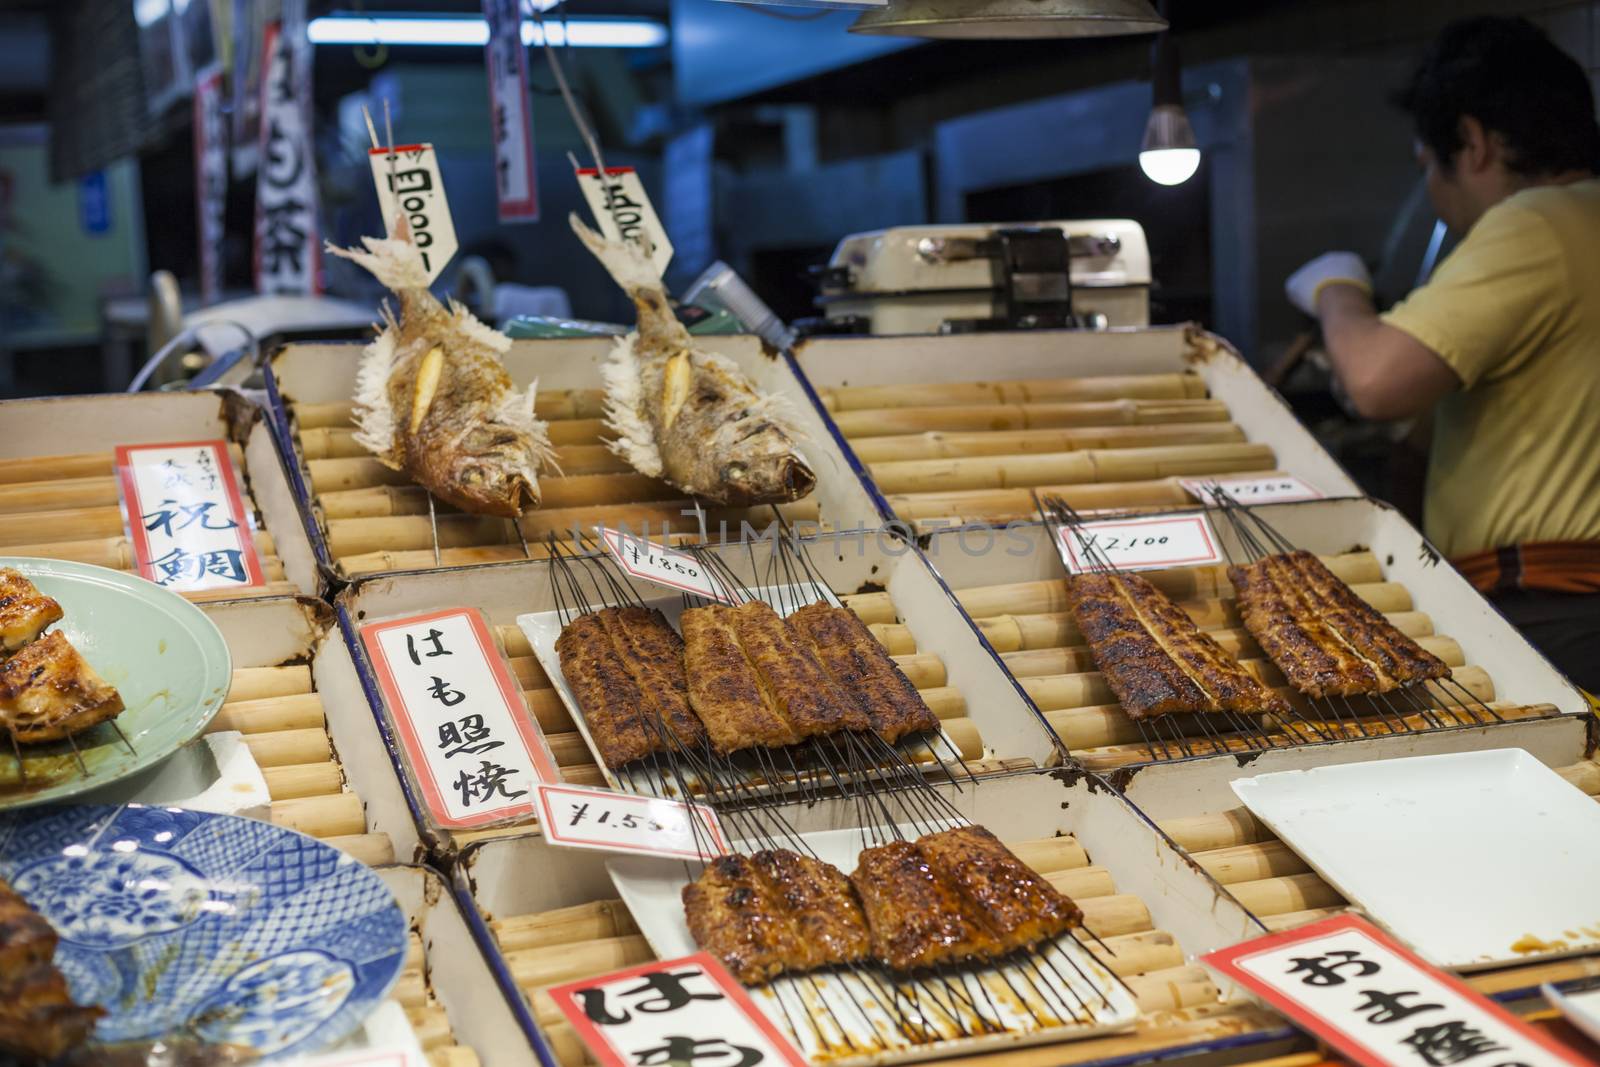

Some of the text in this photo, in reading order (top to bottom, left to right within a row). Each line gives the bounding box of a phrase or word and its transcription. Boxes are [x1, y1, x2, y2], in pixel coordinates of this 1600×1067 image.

[141, 499, 247, 586] 祝鯛
[407, 629, 530, 808] はも照焼
